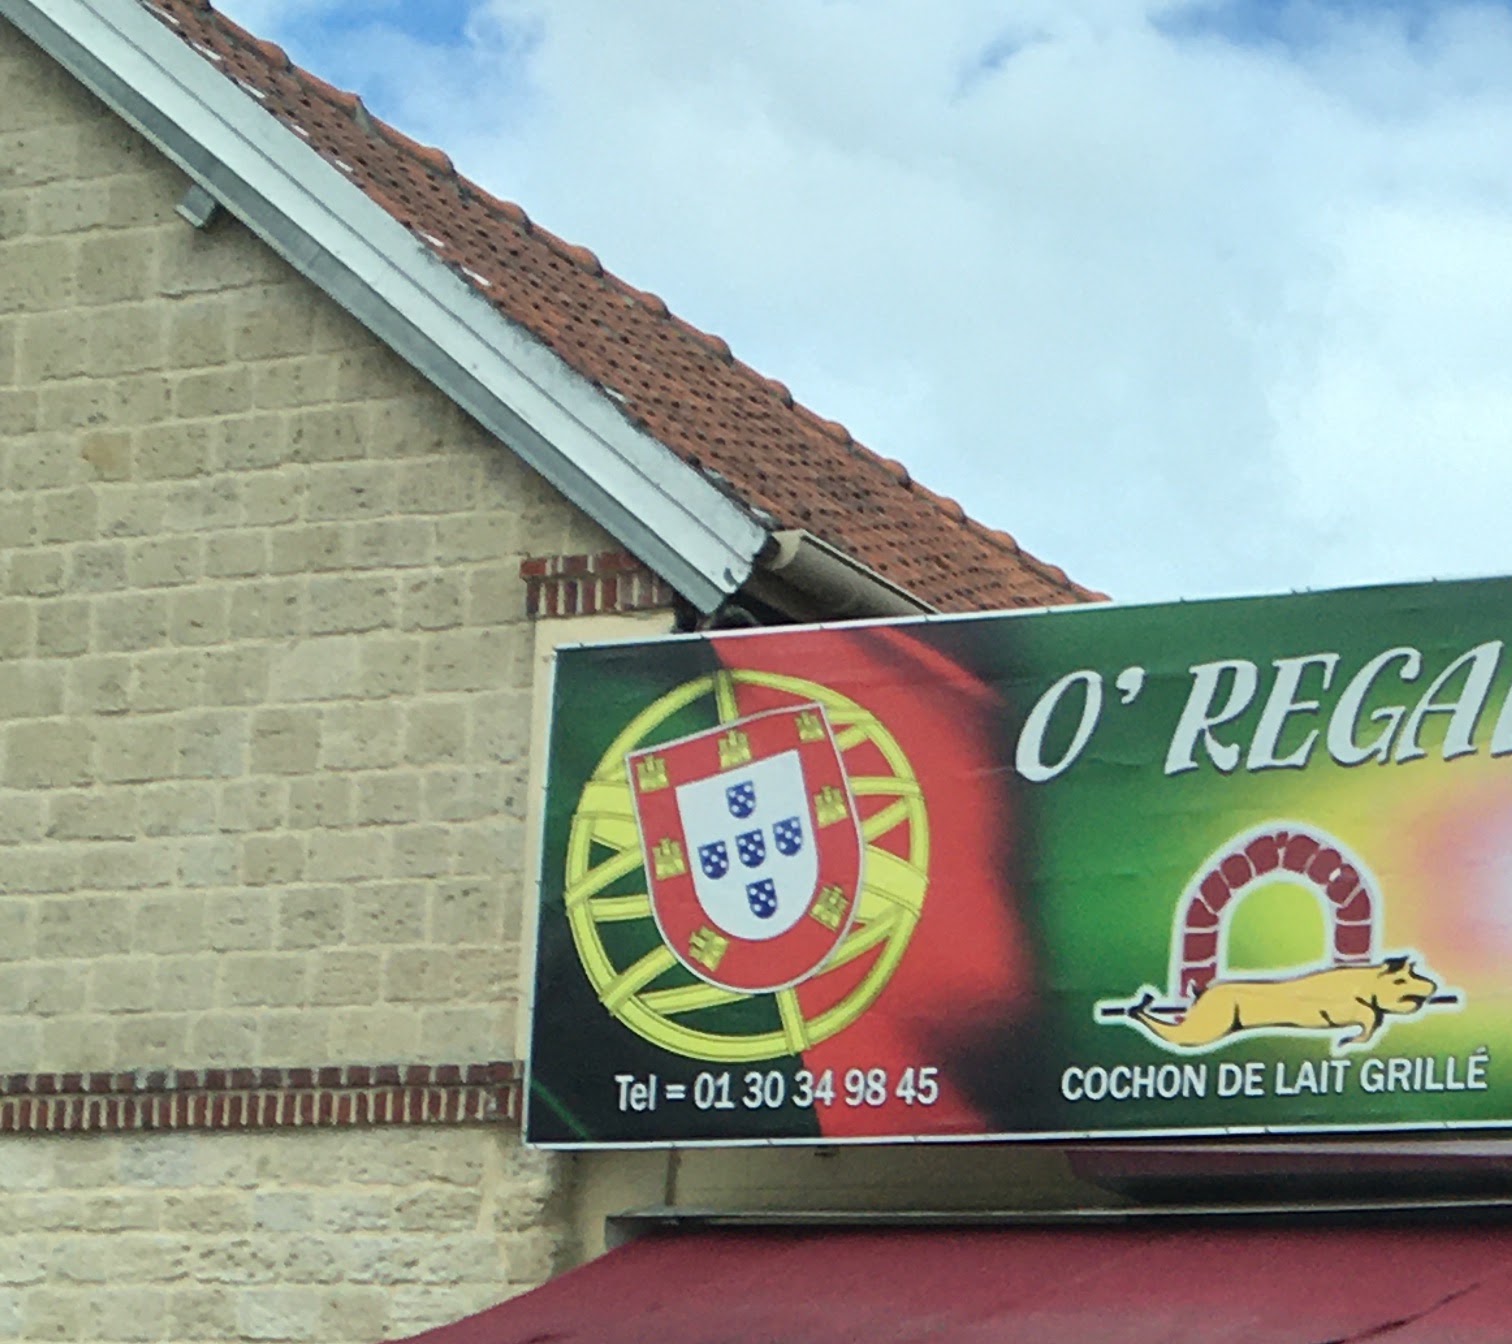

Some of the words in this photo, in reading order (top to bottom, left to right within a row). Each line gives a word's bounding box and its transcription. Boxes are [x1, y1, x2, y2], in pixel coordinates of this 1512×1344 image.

[614, 1073, 657, 1112] Tel
[693, 1071, 735, 1109] 01
[742, 1070, 785, 1108] 30
[792, 1069, 835, 1107] 34
[844, 1068, 887, 1107] 98
[895, 1066, 939, 1105] 45
[1061, 1063, 1207, 1101] COCHON
[1217, 1062, 1266, 1098] DE
[1275, 1058, 1351, 1095] LAIT
[1359, 1046, 1491, 1093] GRILLÉ
